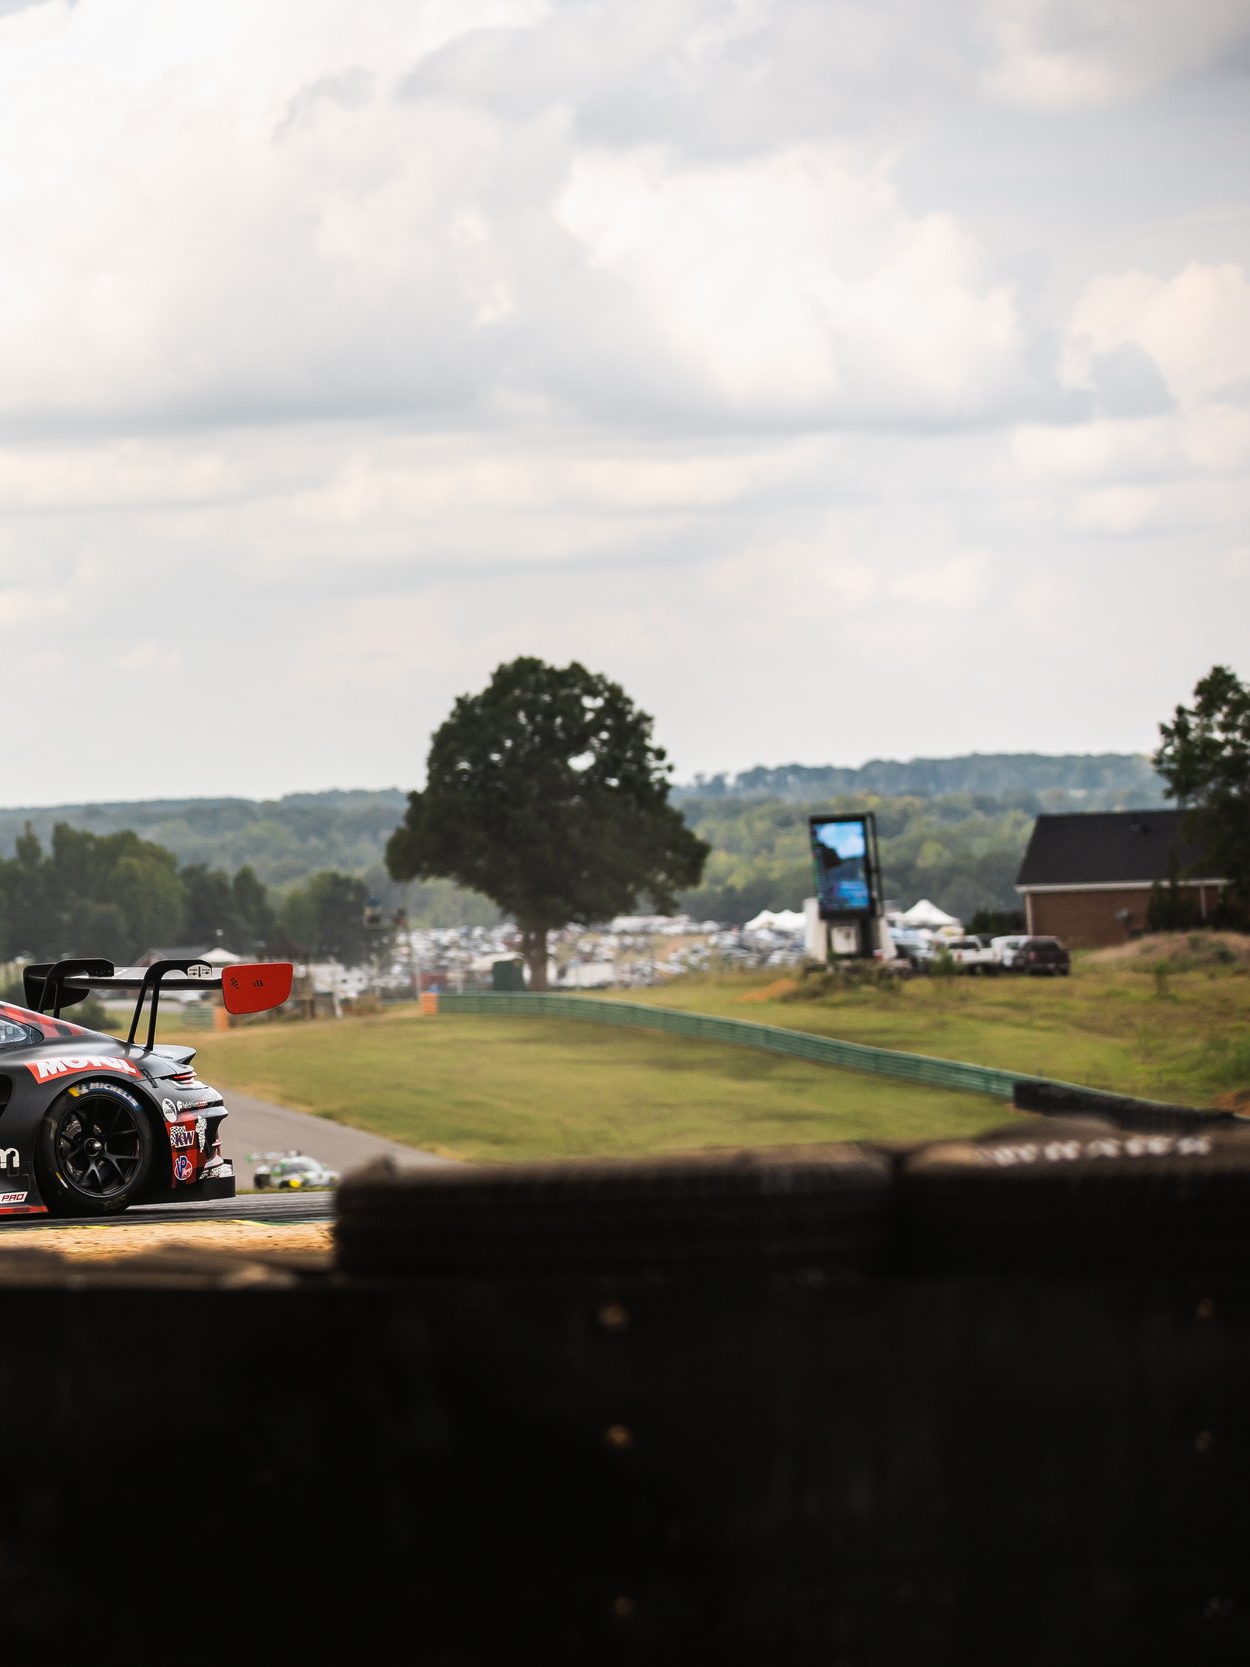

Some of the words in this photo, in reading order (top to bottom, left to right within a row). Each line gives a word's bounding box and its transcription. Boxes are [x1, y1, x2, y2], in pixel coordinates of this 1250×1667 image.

[37, 1056, 136, 1078] MOTUL
[175, 1130, 194, 1146] KW
[176, 1156, 188, 1179] VP
[2, 1193, 25, 1201] PRO
